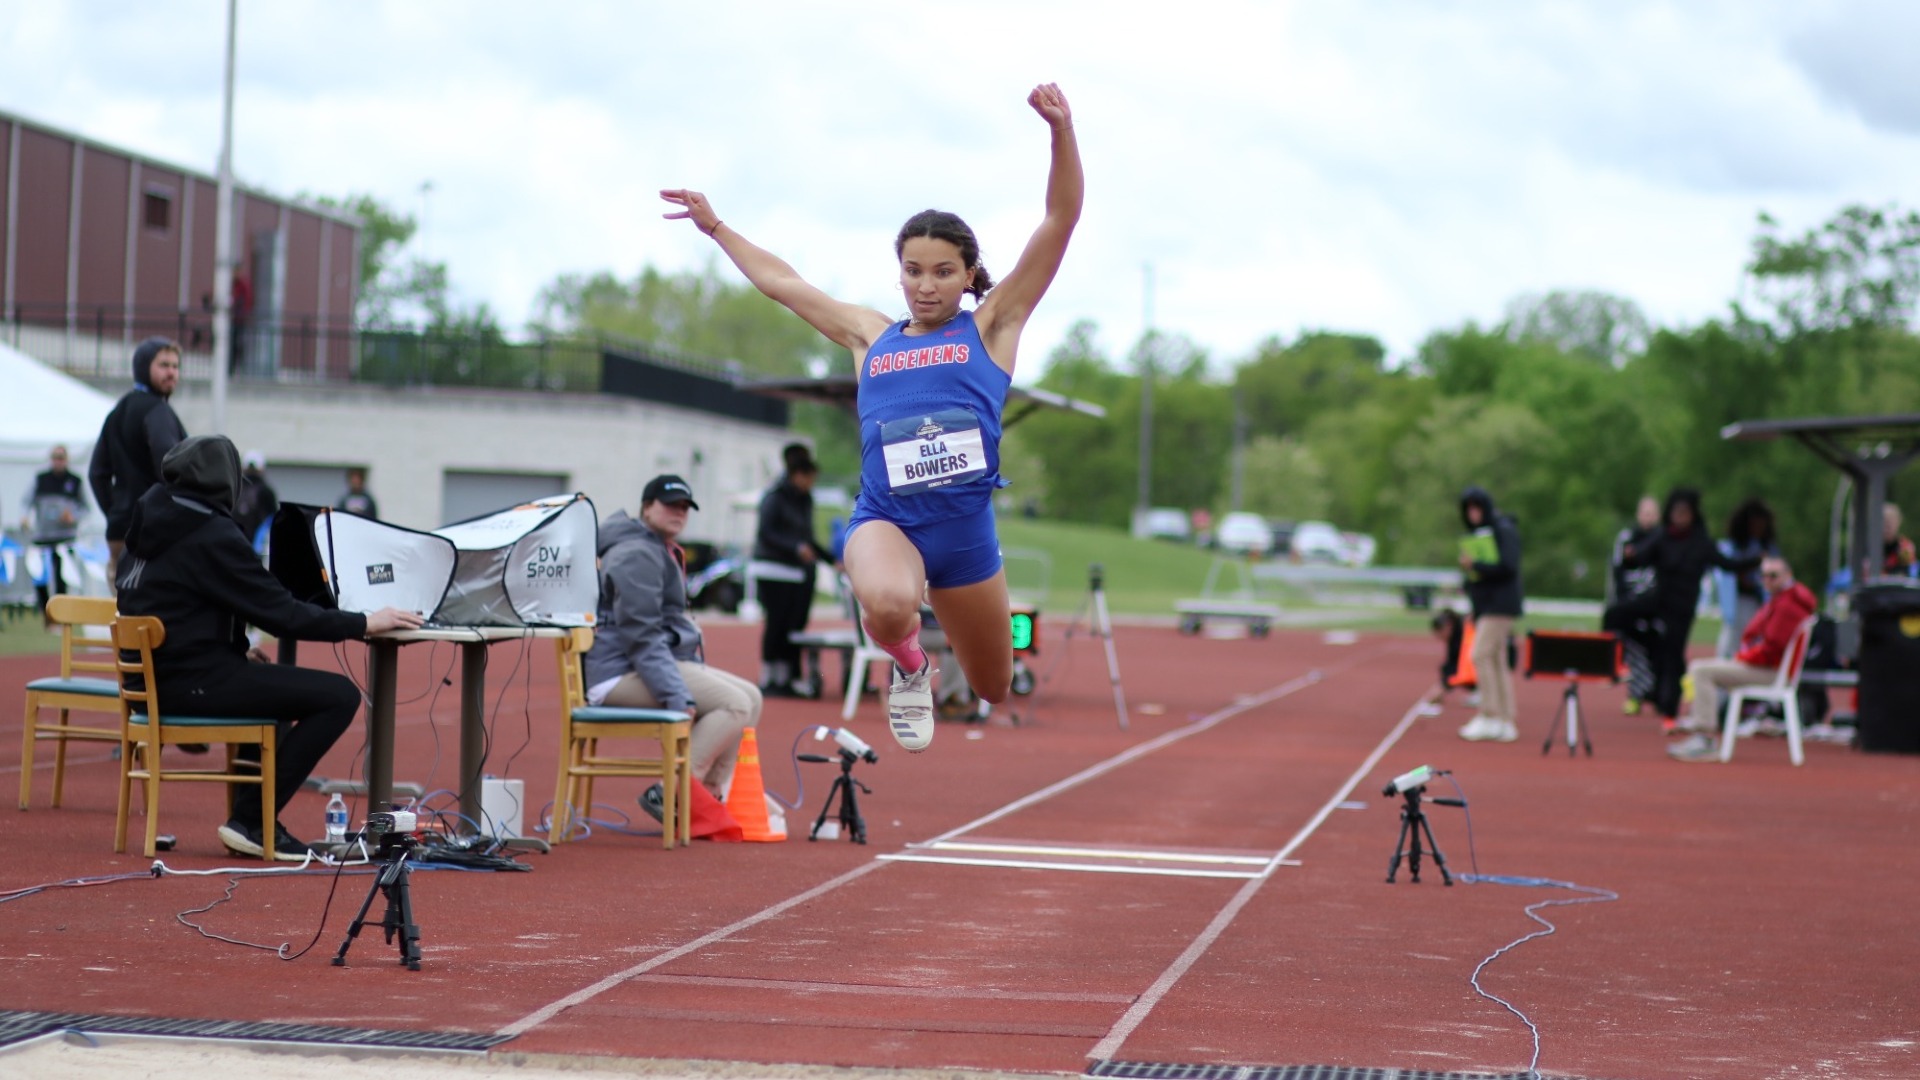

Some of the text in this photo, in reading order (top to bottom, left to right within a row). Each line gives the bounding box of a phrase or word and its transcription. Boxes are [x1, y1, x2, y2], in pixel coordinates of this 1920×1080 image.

[869, 344, 969, 377] SAGEHENS
[920, 441, 947, 457] ELLA
[904, 453, 968, 480] BOWERS
[539, 547, 560, 562] DV
[527, 562, 571, 578] SPORT
